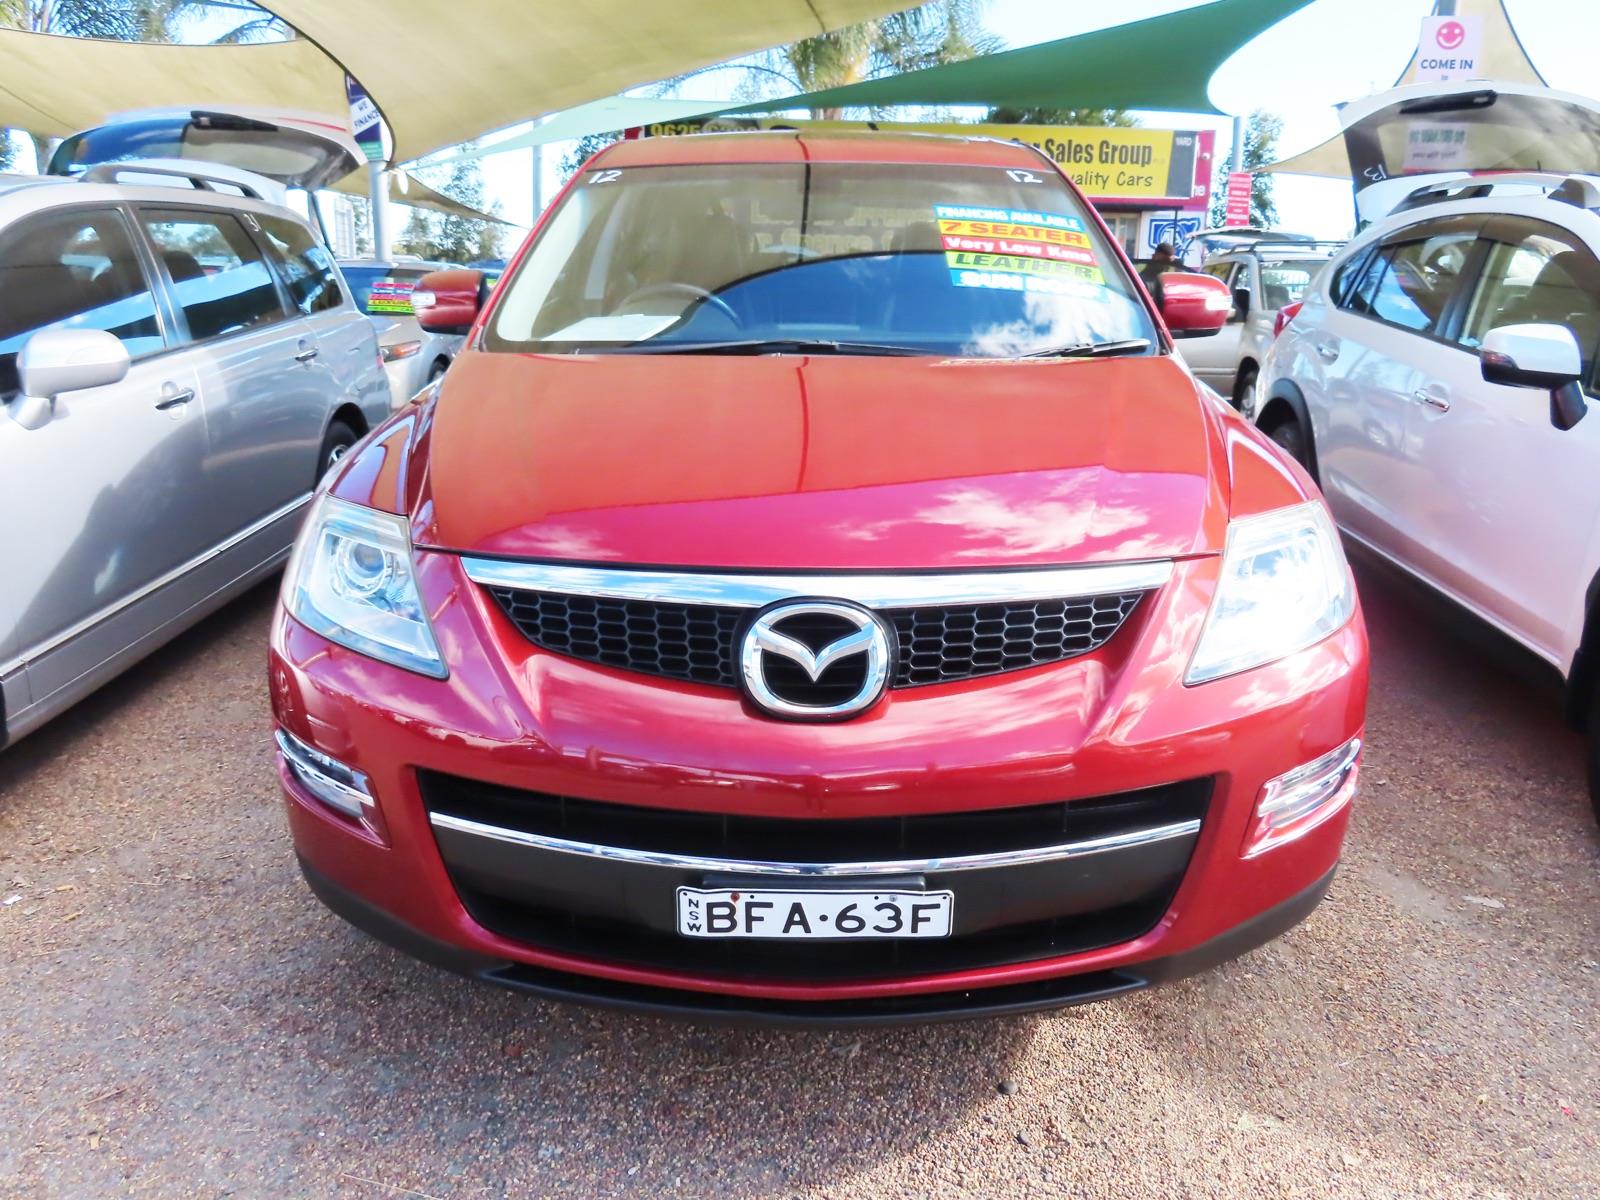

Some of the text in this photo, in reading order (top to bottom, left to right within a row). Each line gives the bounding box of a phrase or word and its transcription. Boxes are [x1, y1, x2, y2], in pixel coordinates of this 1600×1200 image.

[1420, 59, 1473, 70] COME IN
[1045, 138, 1094, 164] Sales
[1098, 140, 1153, 168] Group
[588, 170, 623, 184] 12
[1005, 169, 1044, 184] 12
[1116, 171, 1153, 187] Cars
[942, 221, 1083, 245] 7 SEATER
[945, 236, 1094, 263] Very Low Kms
[955, 253, 1094, 280] LEATHER
[687, 898, 702, 934] NSW
